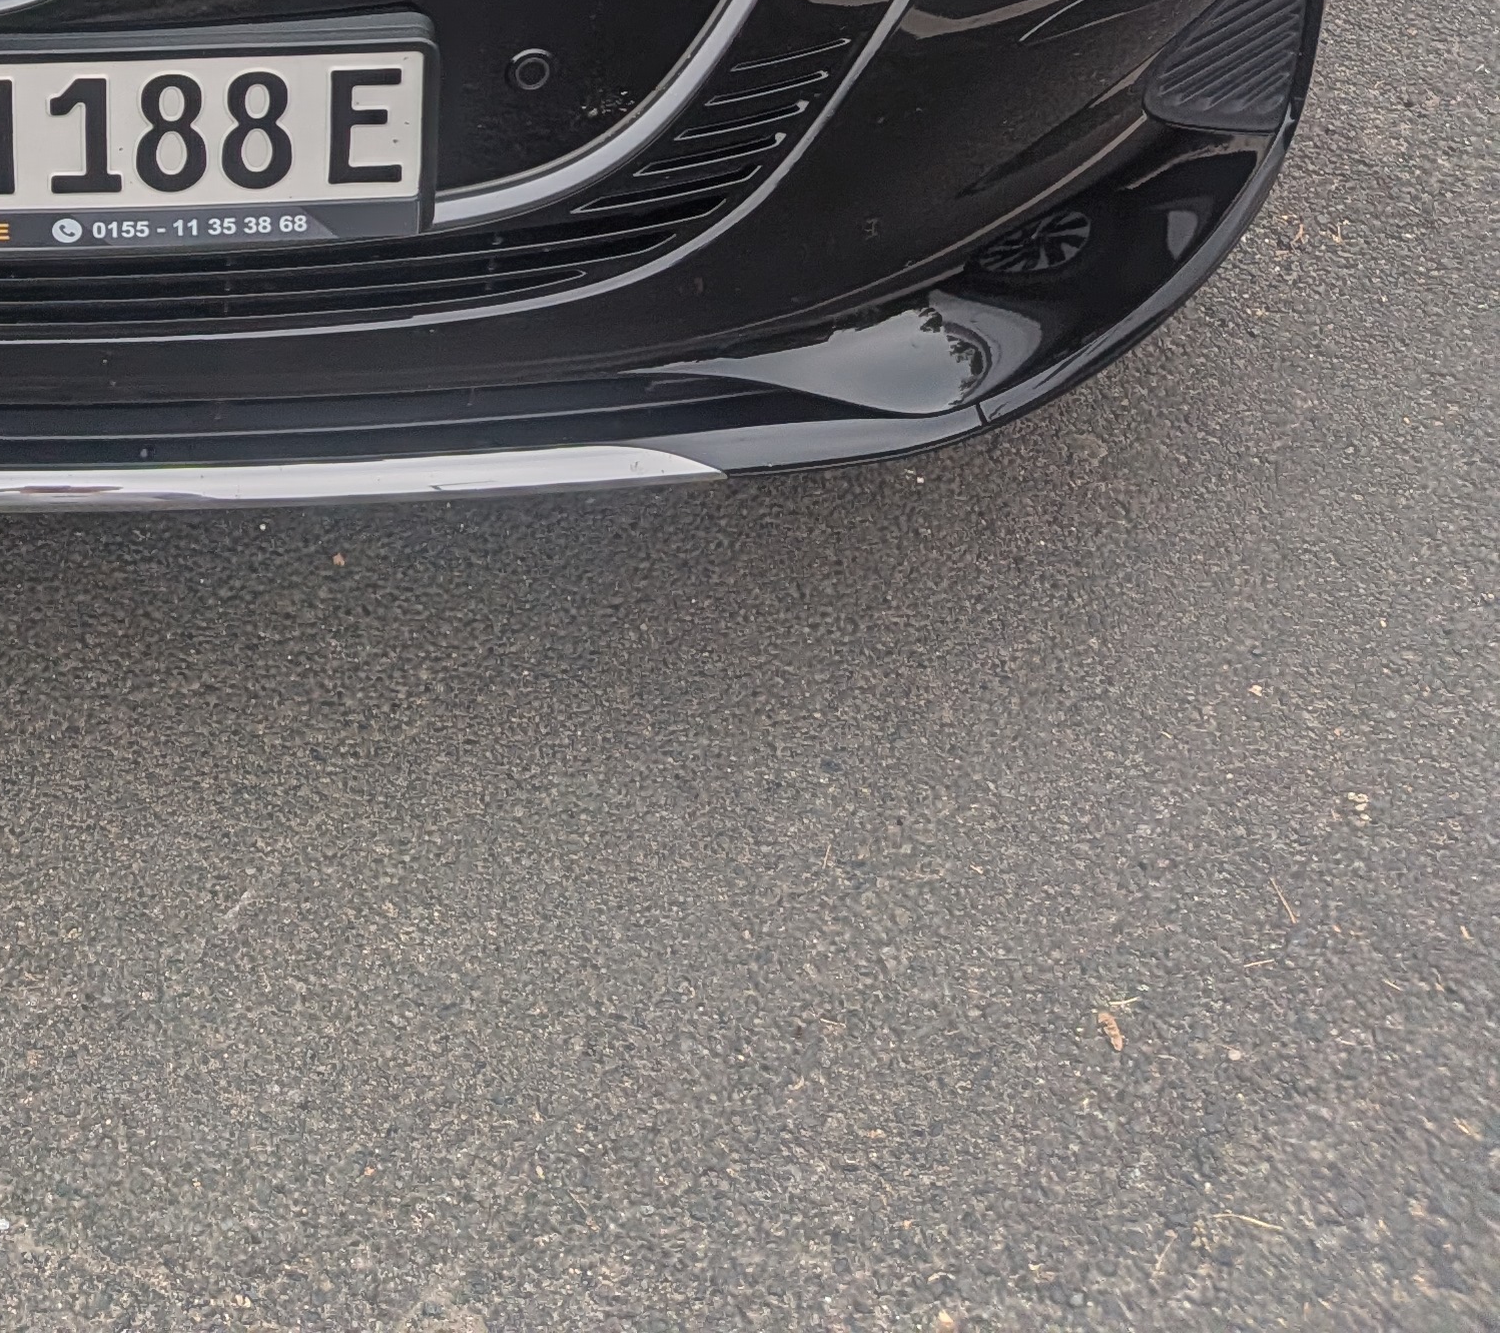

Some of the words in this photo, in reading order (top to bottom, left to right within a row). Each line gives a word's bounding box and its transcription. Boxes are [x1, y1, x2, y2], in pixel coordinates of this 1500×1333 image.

[92, 221, 150, 239] 0155
[173, 219, 198, 237] 11
[208, 218, 237, 235] 35
[243, 216, 272, 234] 38
[279, 215, 308, 233] 68
